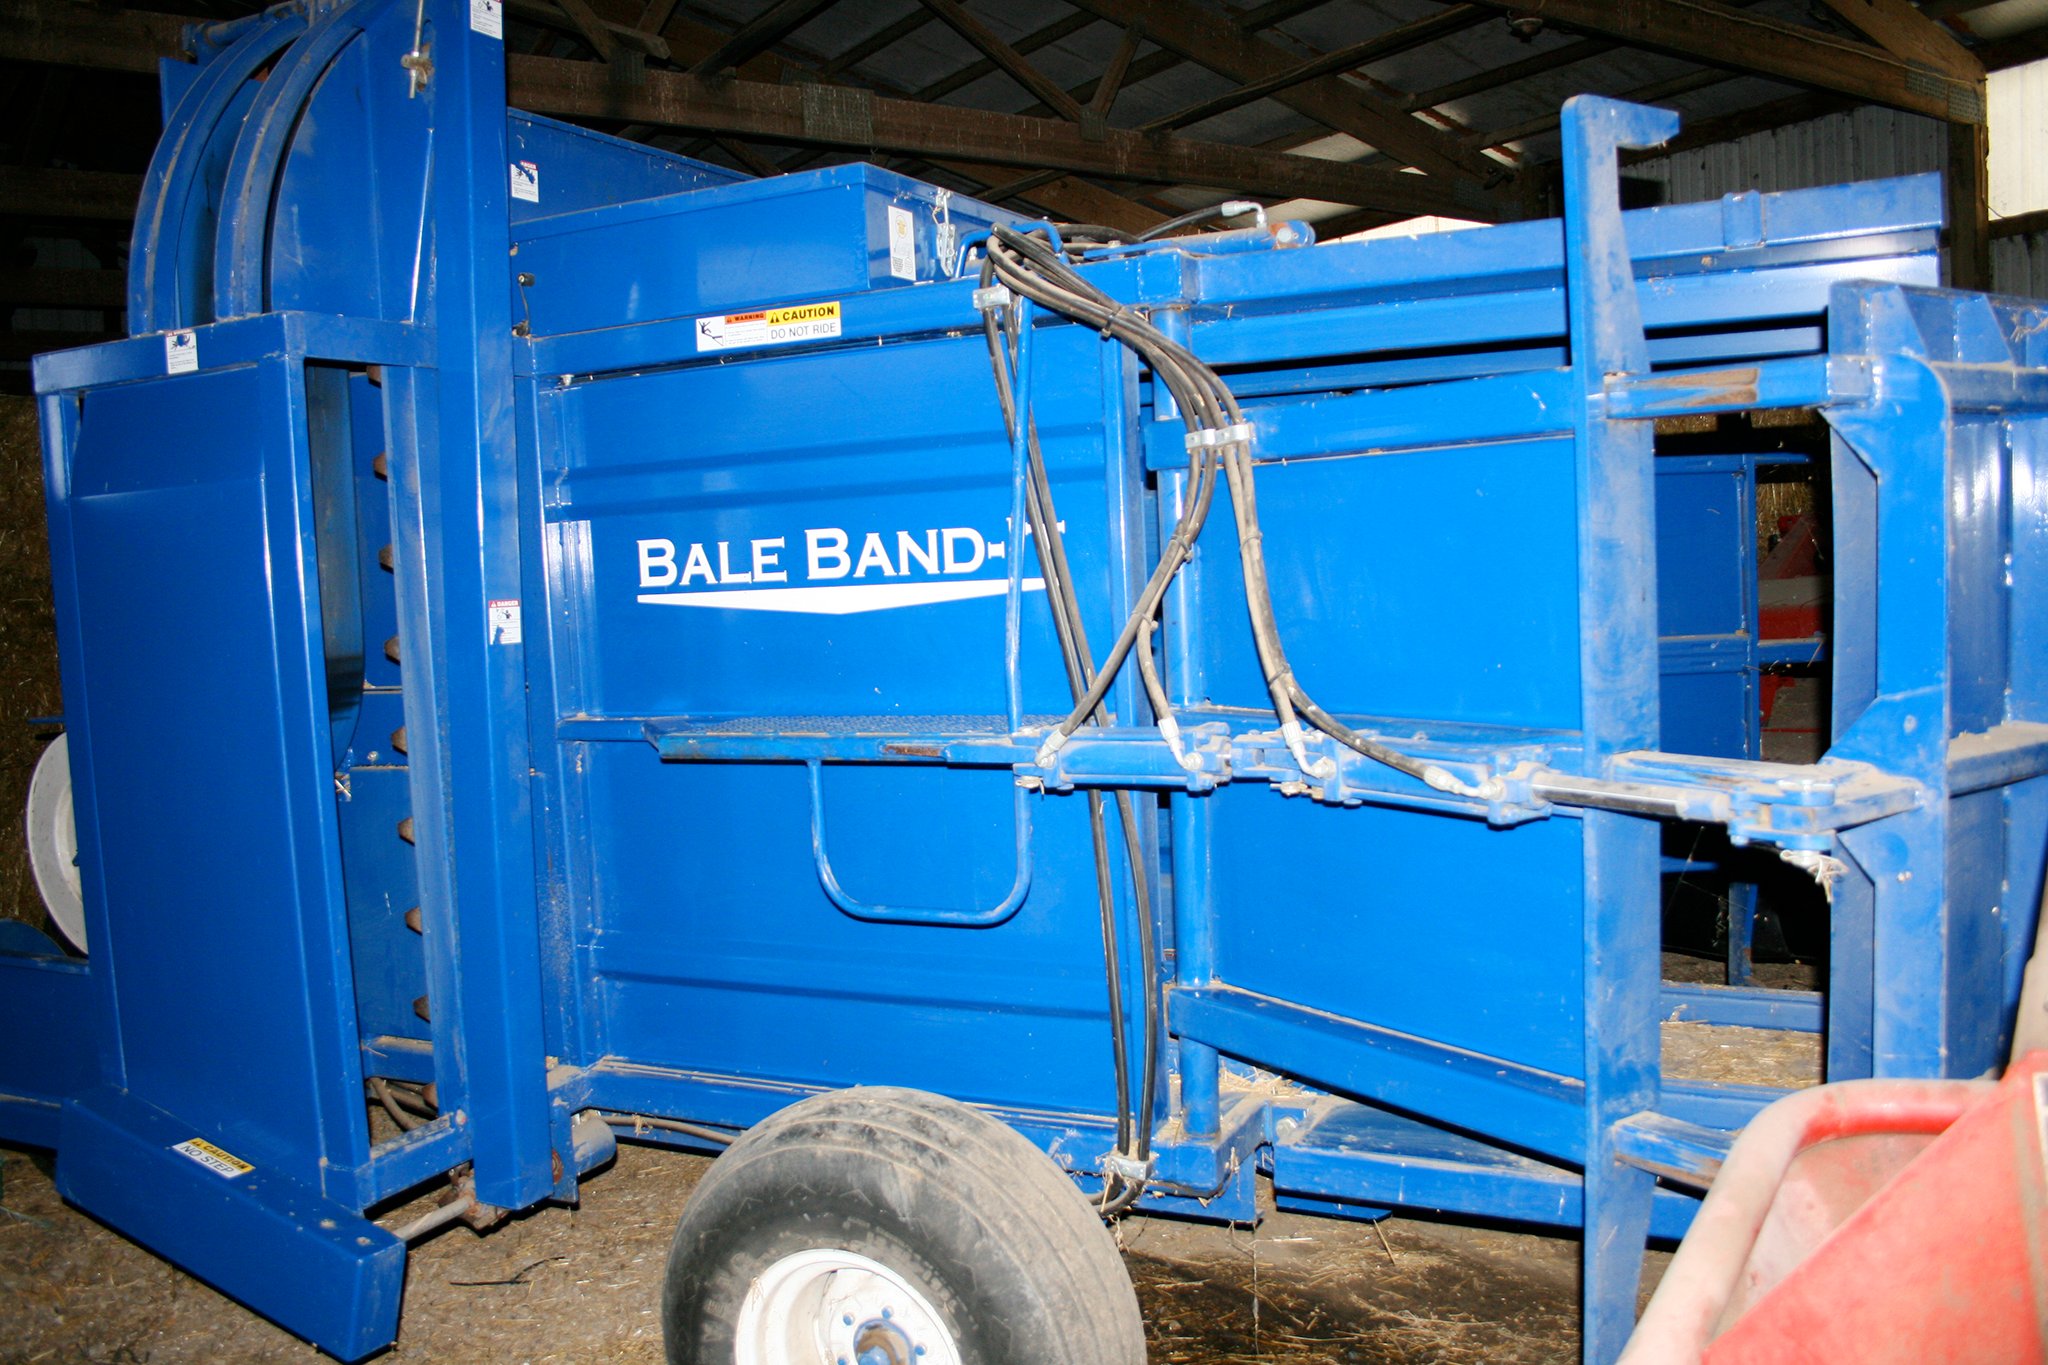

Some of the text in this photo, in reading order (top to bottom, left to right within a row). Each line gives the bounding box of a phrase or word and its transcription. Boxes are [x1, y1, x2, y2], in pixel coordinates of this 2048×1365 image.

[734, 312, 764, 321] WARNING
[782, 306, 835, 321] CAUTION
[771, 328, 786, 340] DO
[789, 325, 810, 338] NOT
[812, 322, 836, 334] RIDE
[636, 516, 1066, 588] BALE BAND-
[180, 1145, 234, 1173] NO STEP
[203, 1145, 249, 1169] CAUTION
